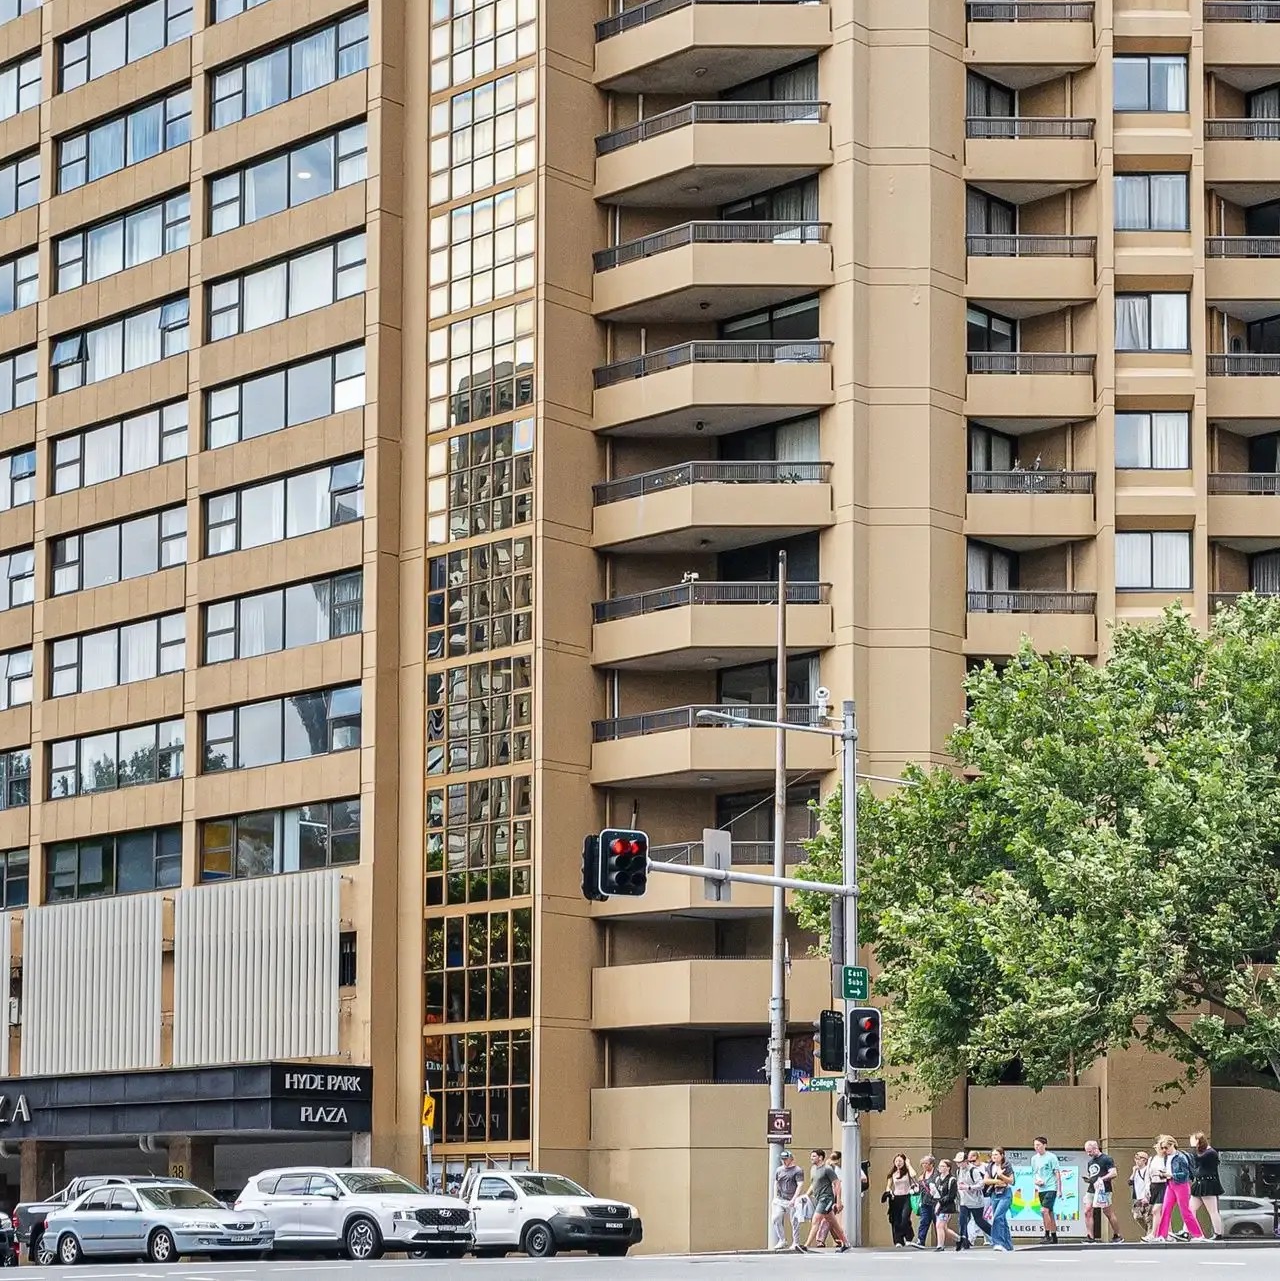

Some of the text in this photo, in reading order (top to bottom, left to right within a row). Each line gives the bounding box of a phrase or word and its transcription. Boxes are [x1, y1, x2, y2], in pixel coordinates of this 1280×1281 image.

[847, 969, 863, 977] East
[285, 1073, 361, 1091] HYDE PARK
[810, 1079, 834, 1088] College
[300, 1106, 348, 1123] PLAZA
[172, 1165, 184, 1178] 38
